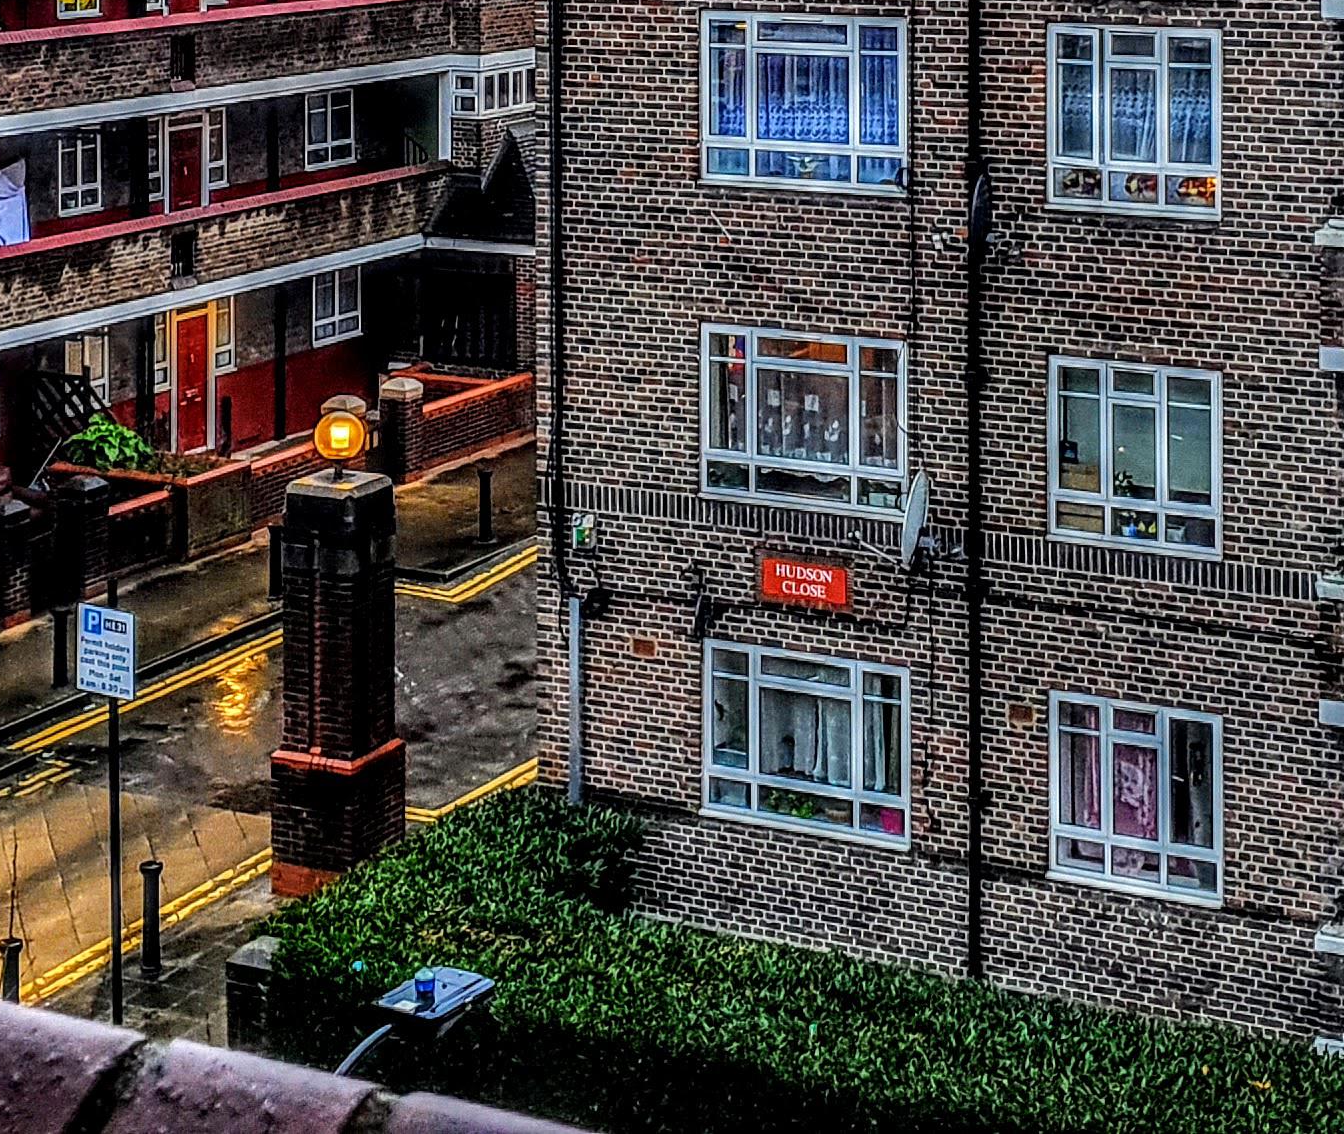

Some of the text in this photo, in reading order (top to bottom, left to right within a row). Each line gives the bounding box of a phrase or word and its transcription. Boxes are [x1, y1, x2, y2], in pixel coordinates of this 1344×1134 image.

[776, 563, 833, 583] HUDSON
[782, 580, 826, 598] CLOSE
[88, 611, 99, 631] P
[84, 648, 126, 663] parking only
